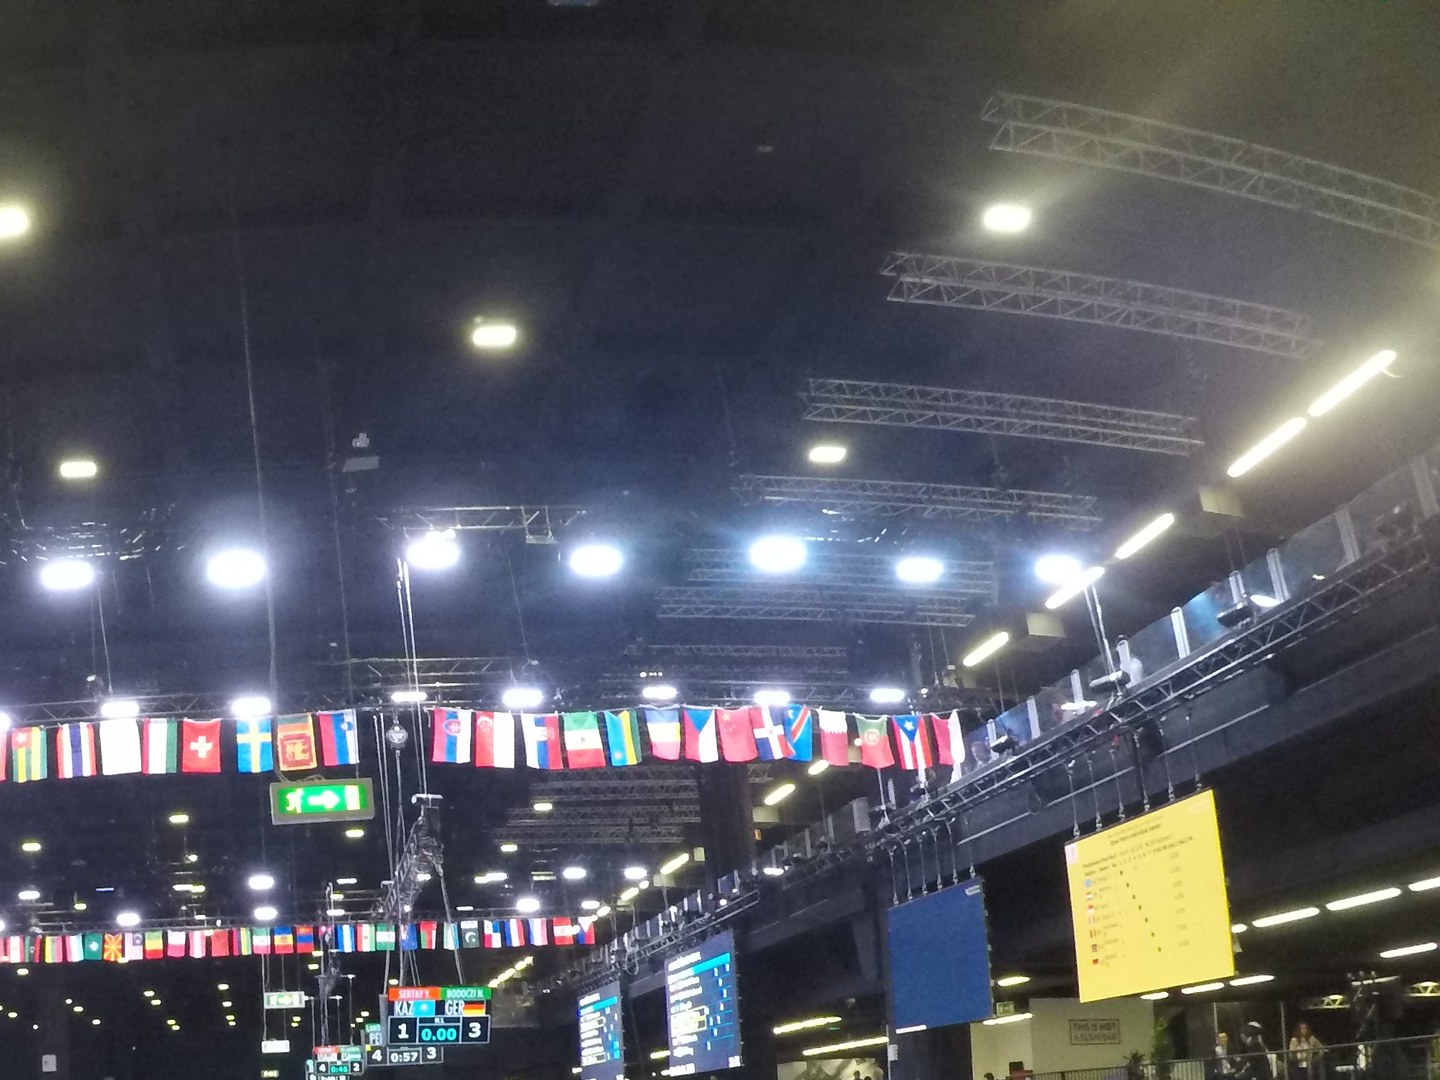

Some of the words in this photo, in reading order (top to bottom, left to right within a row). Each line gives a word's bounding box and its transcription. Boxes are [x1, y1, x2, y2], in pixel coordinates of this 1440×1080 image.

[398, 988, 423, 999] SERTAY
[446, 988, 476, 999] BODOCZI
[395, 1000, 414, 1016] KAZ
[444, 1000, 465, 1016] GER
[397, 1023, 409, 1039] 1
[421, 1028, 457, 1041] 0.00
[468, 1022, 481, 1038] 3
[371, 1049, 383, 1062] 4
[390, 1051, 418, 1063] 0:57
[426, 1047, 437, 1060] 3
